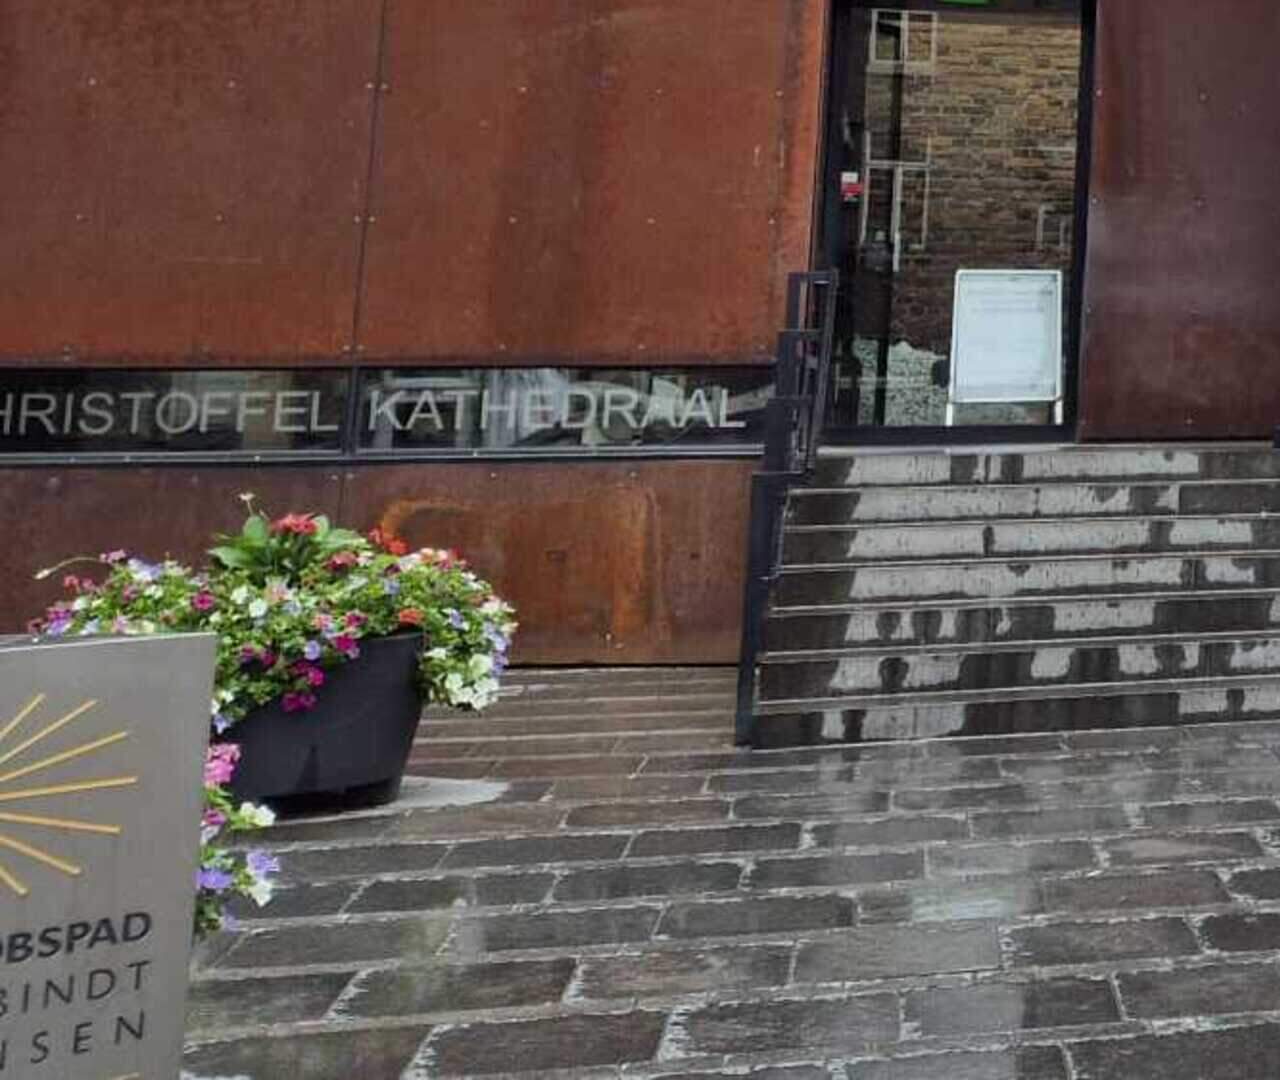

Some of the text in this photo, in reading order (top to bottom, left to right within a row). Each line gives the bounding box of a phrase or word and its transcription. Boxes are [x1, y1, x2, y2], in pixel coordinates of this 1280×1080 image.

[367, 388, 748, 432] KATHEDRAAL
[0, 912, 152, 964] BSPAD
[0, 1008, 145, 1070] SEN
